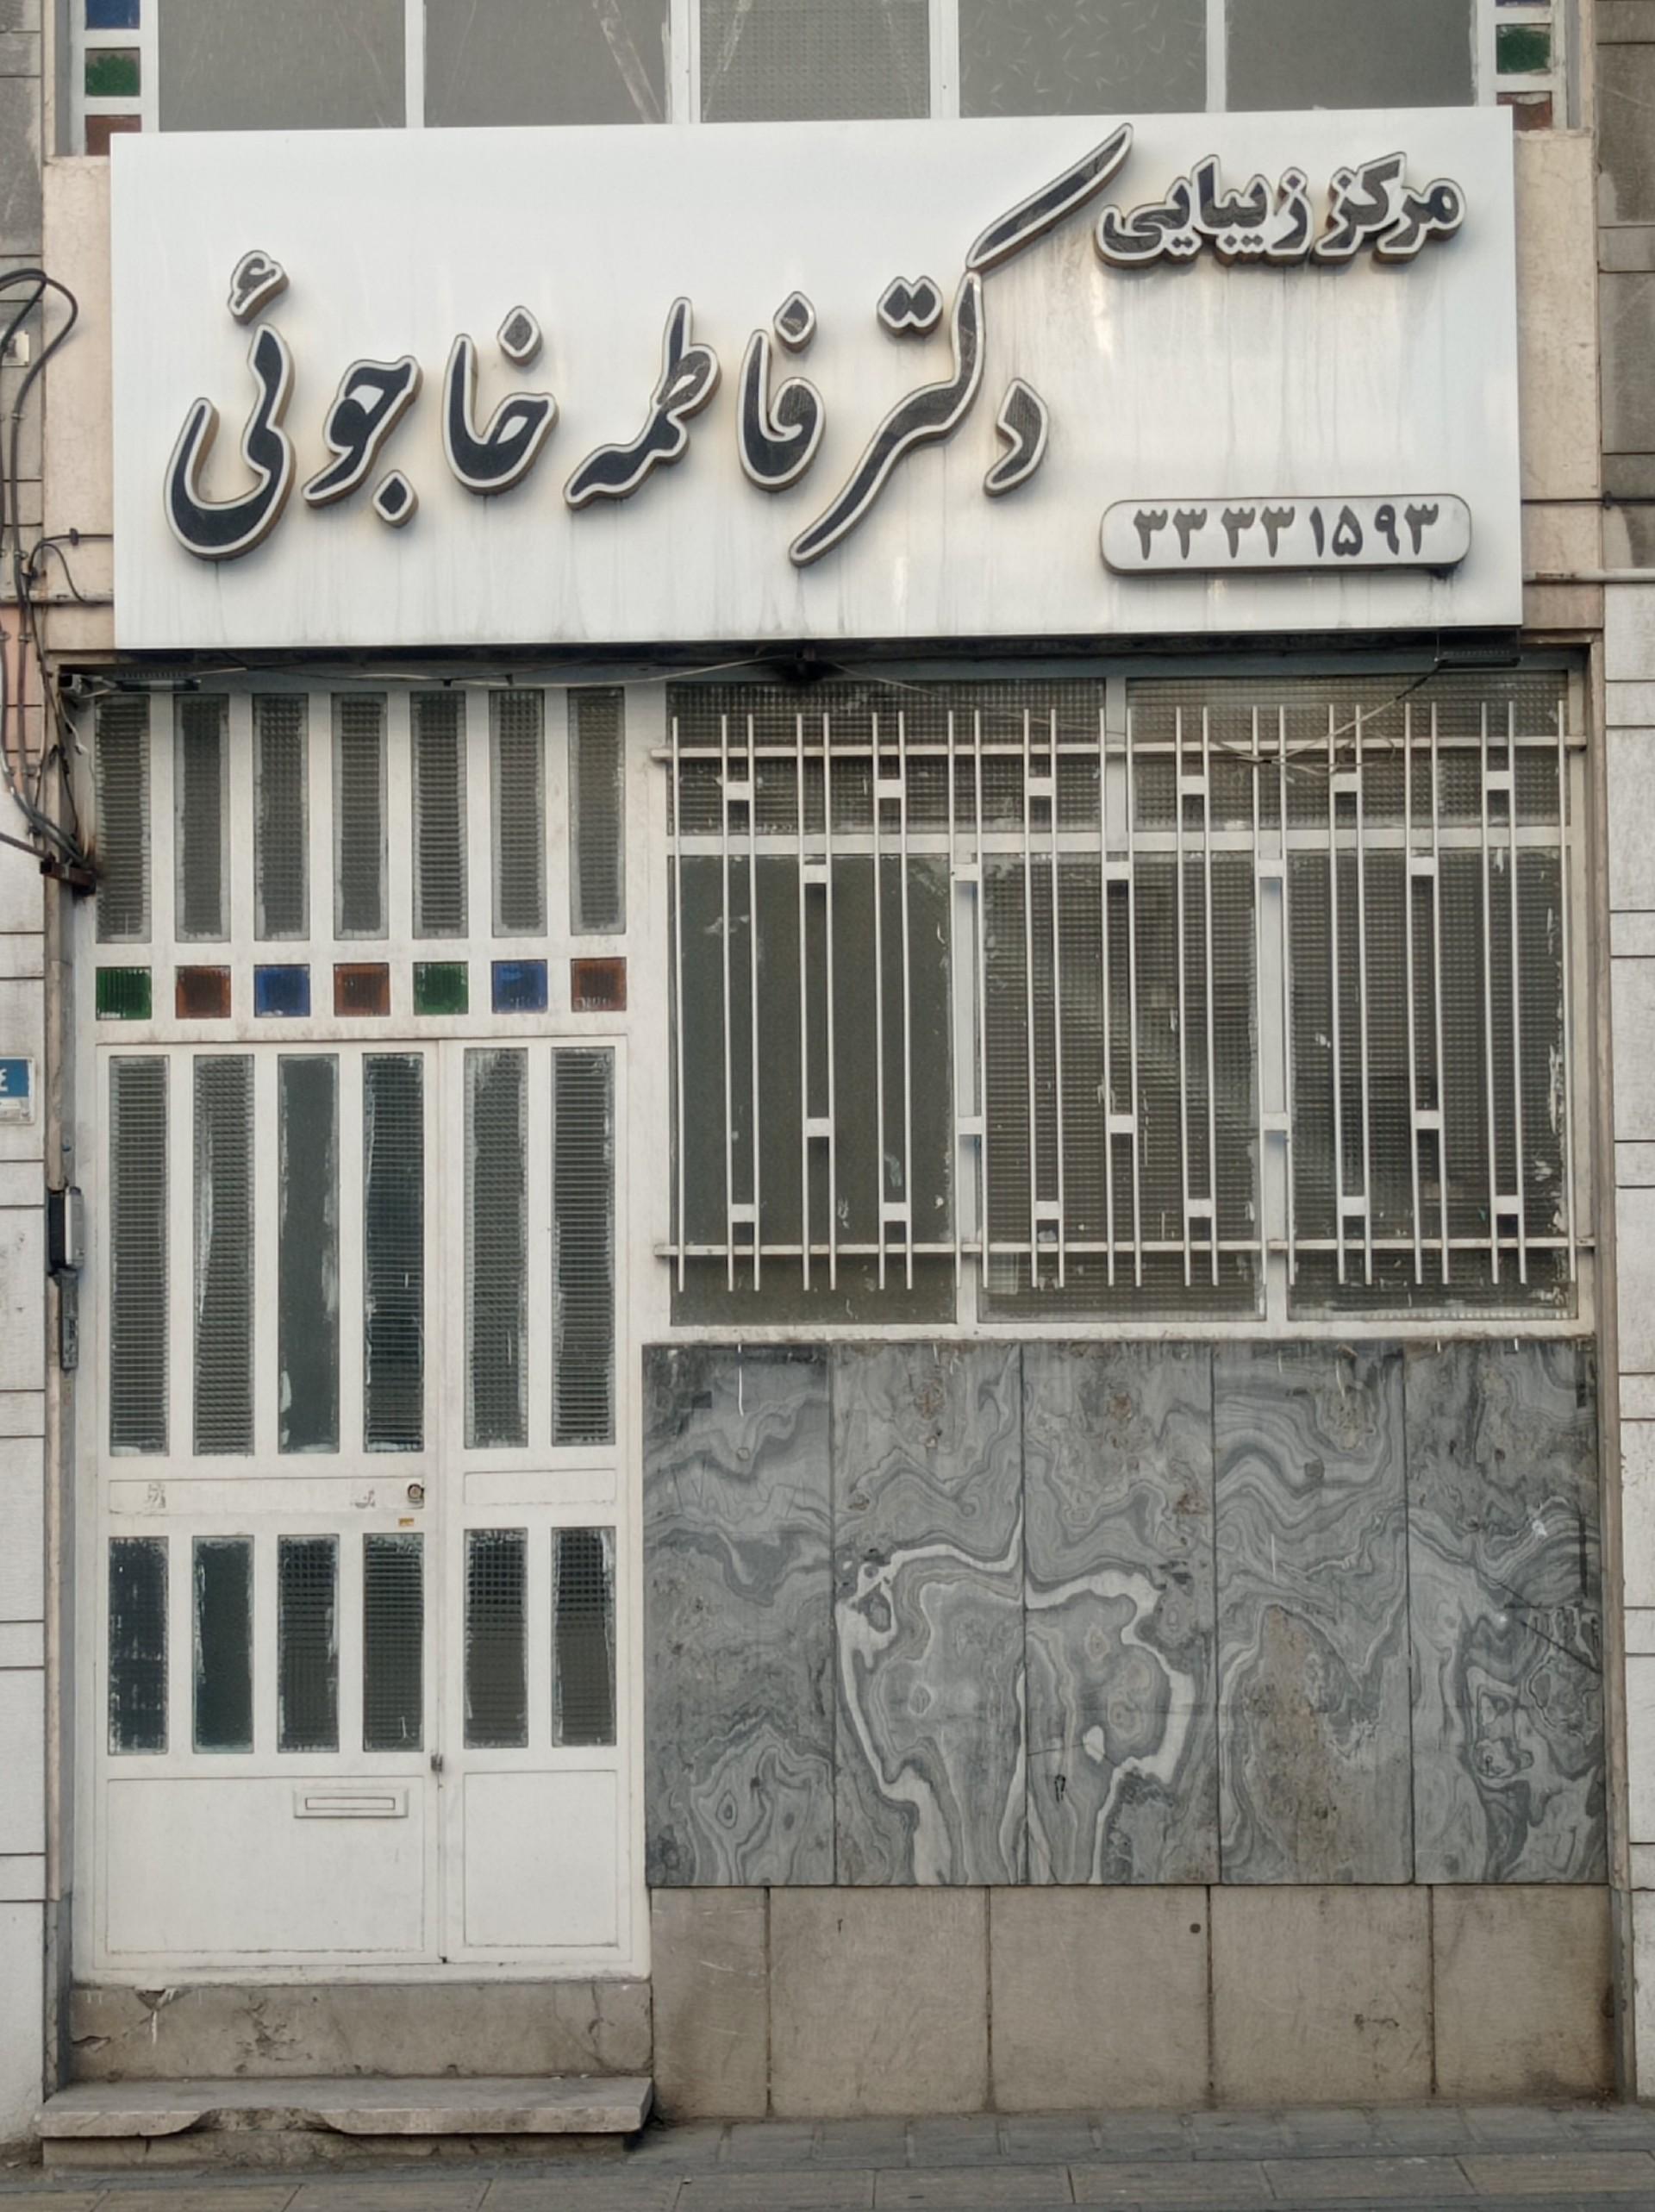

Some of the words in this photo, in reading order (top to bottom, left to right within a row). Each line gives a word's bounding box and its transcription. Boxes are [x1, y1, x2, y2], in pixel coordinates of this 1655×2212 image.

[1095, 154, 1314, 264] زیبایی
[1315, 152, 1467, 262] مرکز
[564, 291, 828, 509] فاطمه
[789, 122, 1134, 566] دکتر
